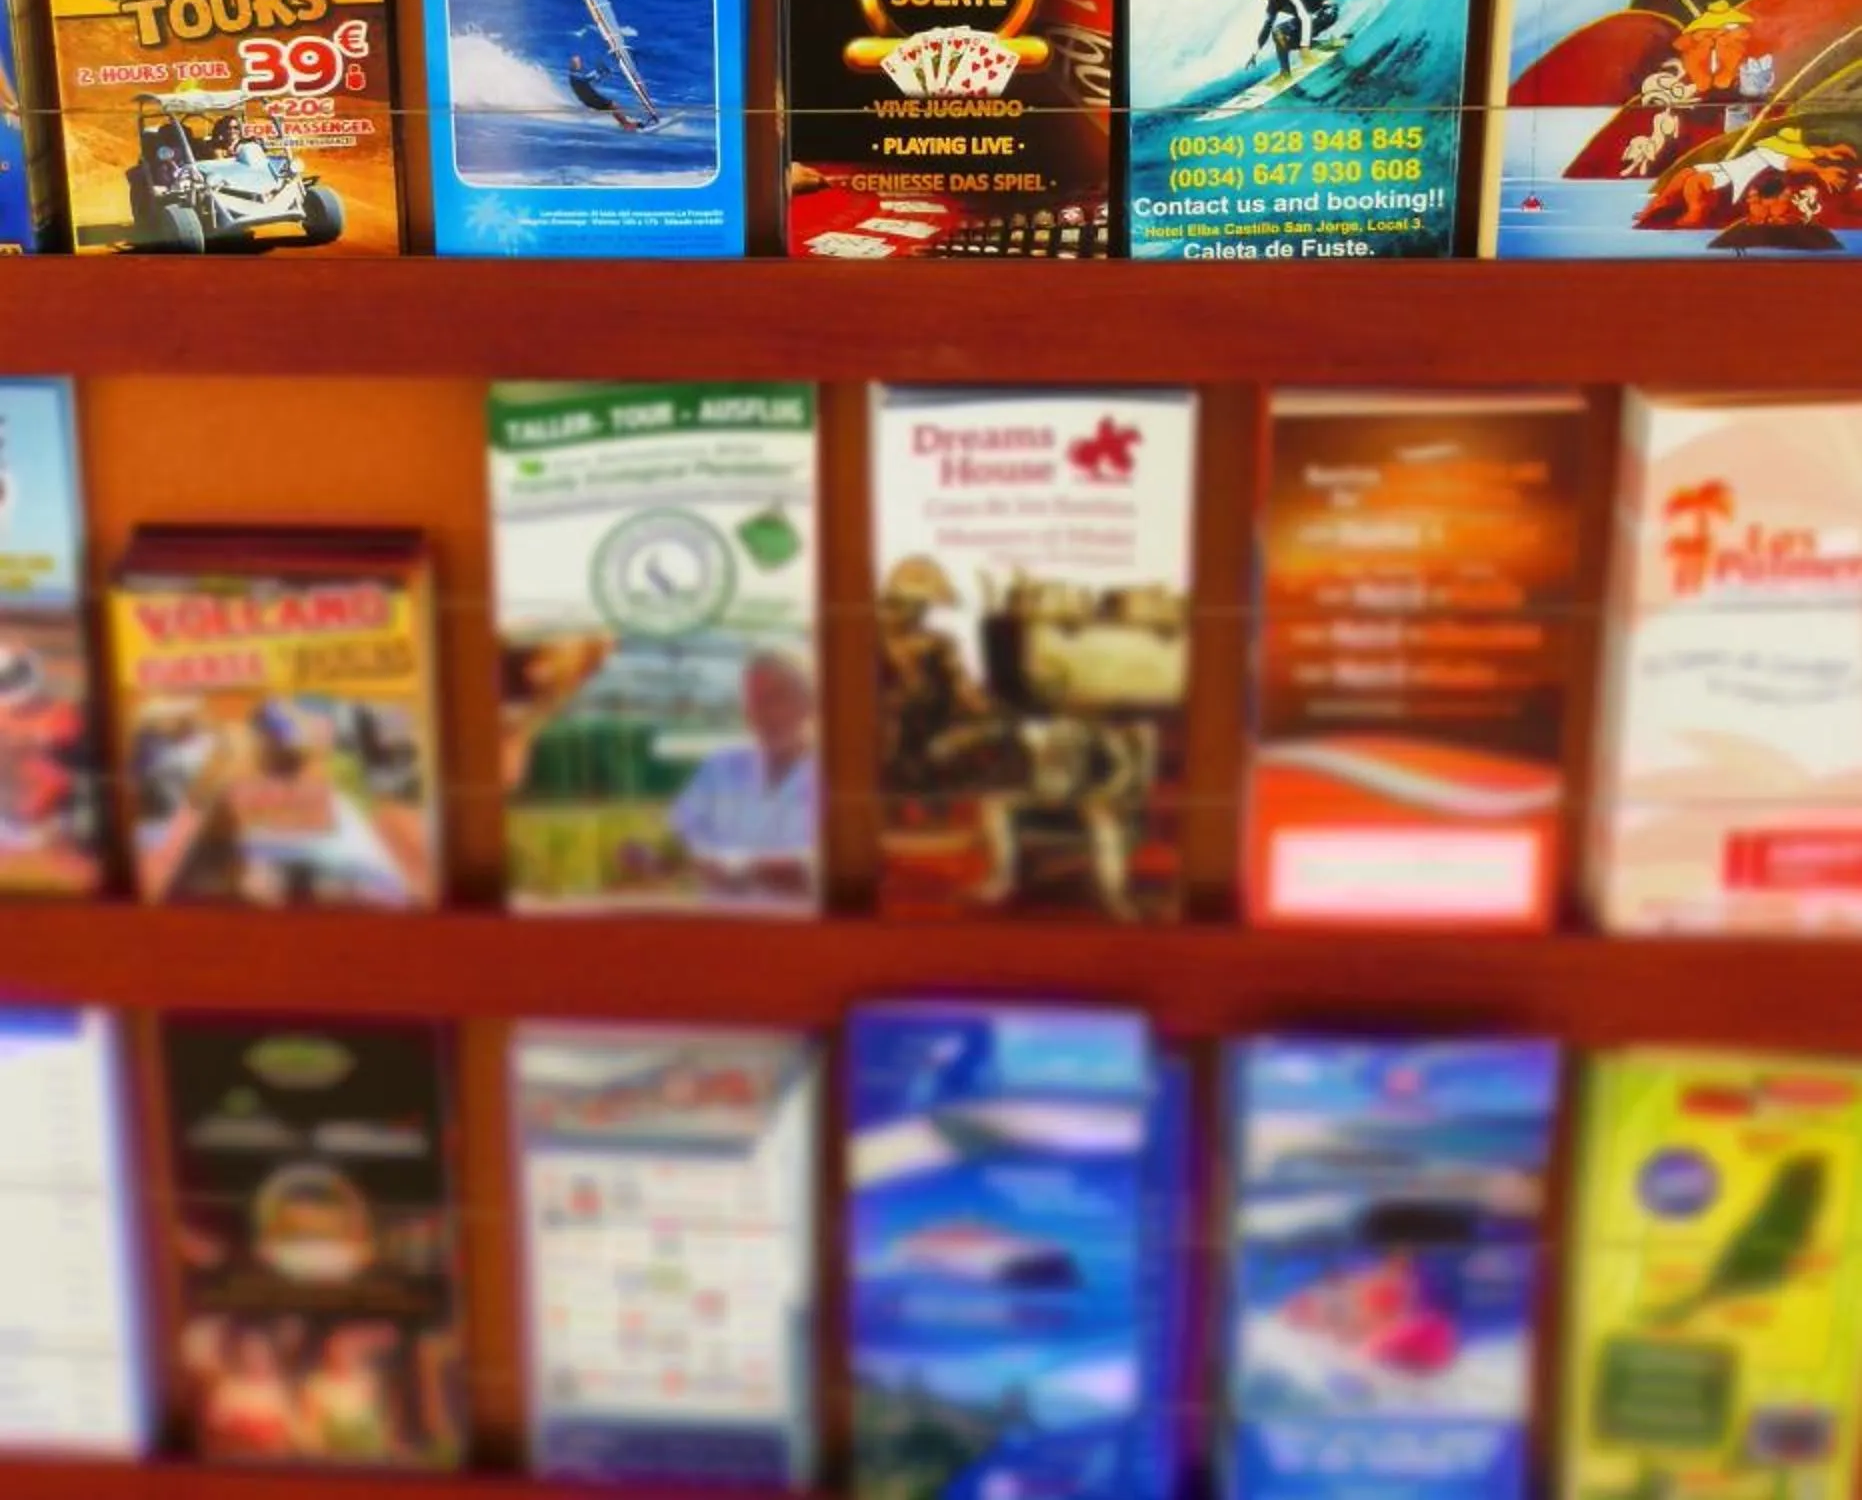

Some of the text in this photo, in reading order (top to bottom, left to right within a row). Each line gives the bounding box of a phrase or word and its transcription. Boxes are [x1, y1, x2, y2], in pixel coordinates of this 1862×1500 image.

[77, 60, 230, 84] 2 HOURS TOUR
[238, 36, 342, 97] 39
[873, 99, 1024, 119] VIVE JUGANDO
[242, 118, 376, 139] FOR PASSENGER
[882, 137, 1014, 155] PLAYING LIVE
[1169, 126, 1423, 161] (0034) 928 948 845
[851, 173, 1047, 192] GENIESSE DAS SPIEL
[1169, 159, 1422, 192] (0034) 647 930 608
[1134, 188, 1445, 217] Contact us and booking!!
[1145, 225, 1183, 238] Hotel
[1187, 223, 1219, 237] Elba
[1223, 221, 1280, 236] Castillo
[1283, 220, 1313, 233] San
[1367, 218, 1409, 231] Local
[1183, 238, 1376, 259] Caleta de Fuste.
[912, 423, 1055, 456] Dreams
[939, 457, 1055, 488] House
